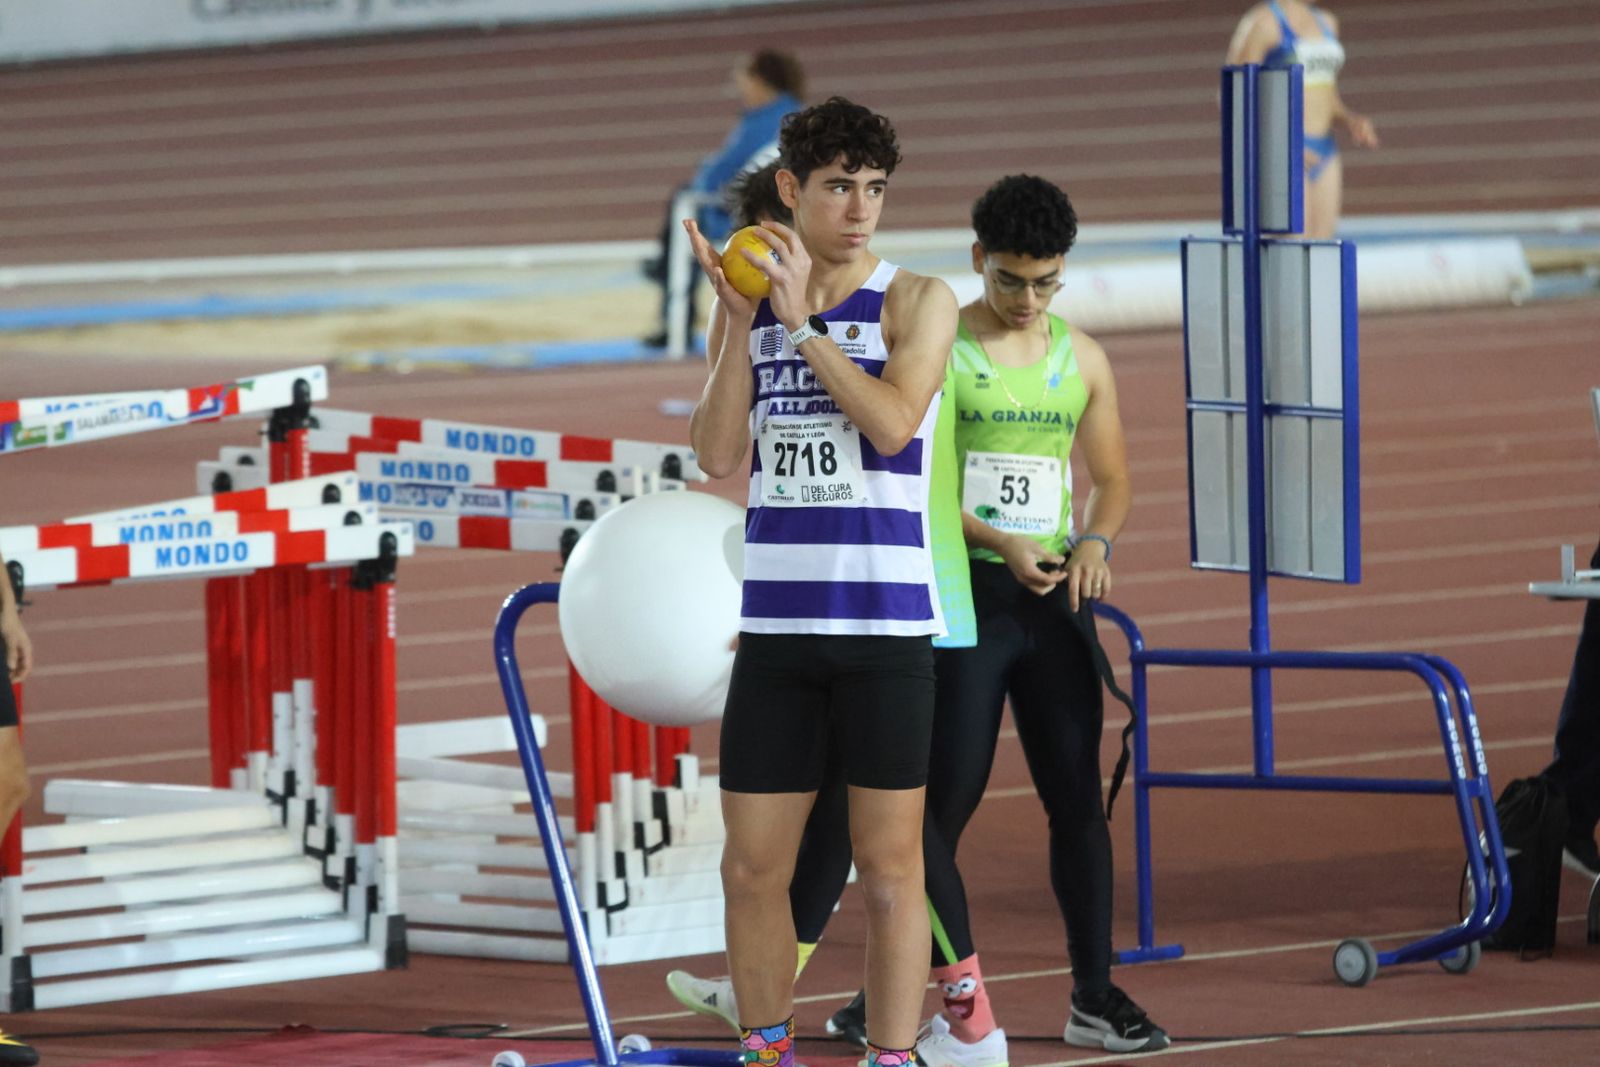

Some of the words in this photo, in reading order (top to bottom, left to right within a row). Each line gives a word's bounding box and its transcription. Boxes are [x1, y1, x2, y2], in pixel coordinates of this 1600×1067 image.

[768, 401, 843, 416] ALLADOL
[960, 410, 985, 423] LA
[992, 410, 1062, 425] GRANJA
[446, 428, 536, 456] MONDO
[774, 441, 838, 477] 2718
[381, 460, 470, 483] MONDO
[811, 485, 826, 494] DEL
[828, 483, 852, 493] CURA
[811, 491, 854, 502] SEGUROS
[1000, 475, 1031, 506] 53
[155, 541, 249, 569] MONDO
